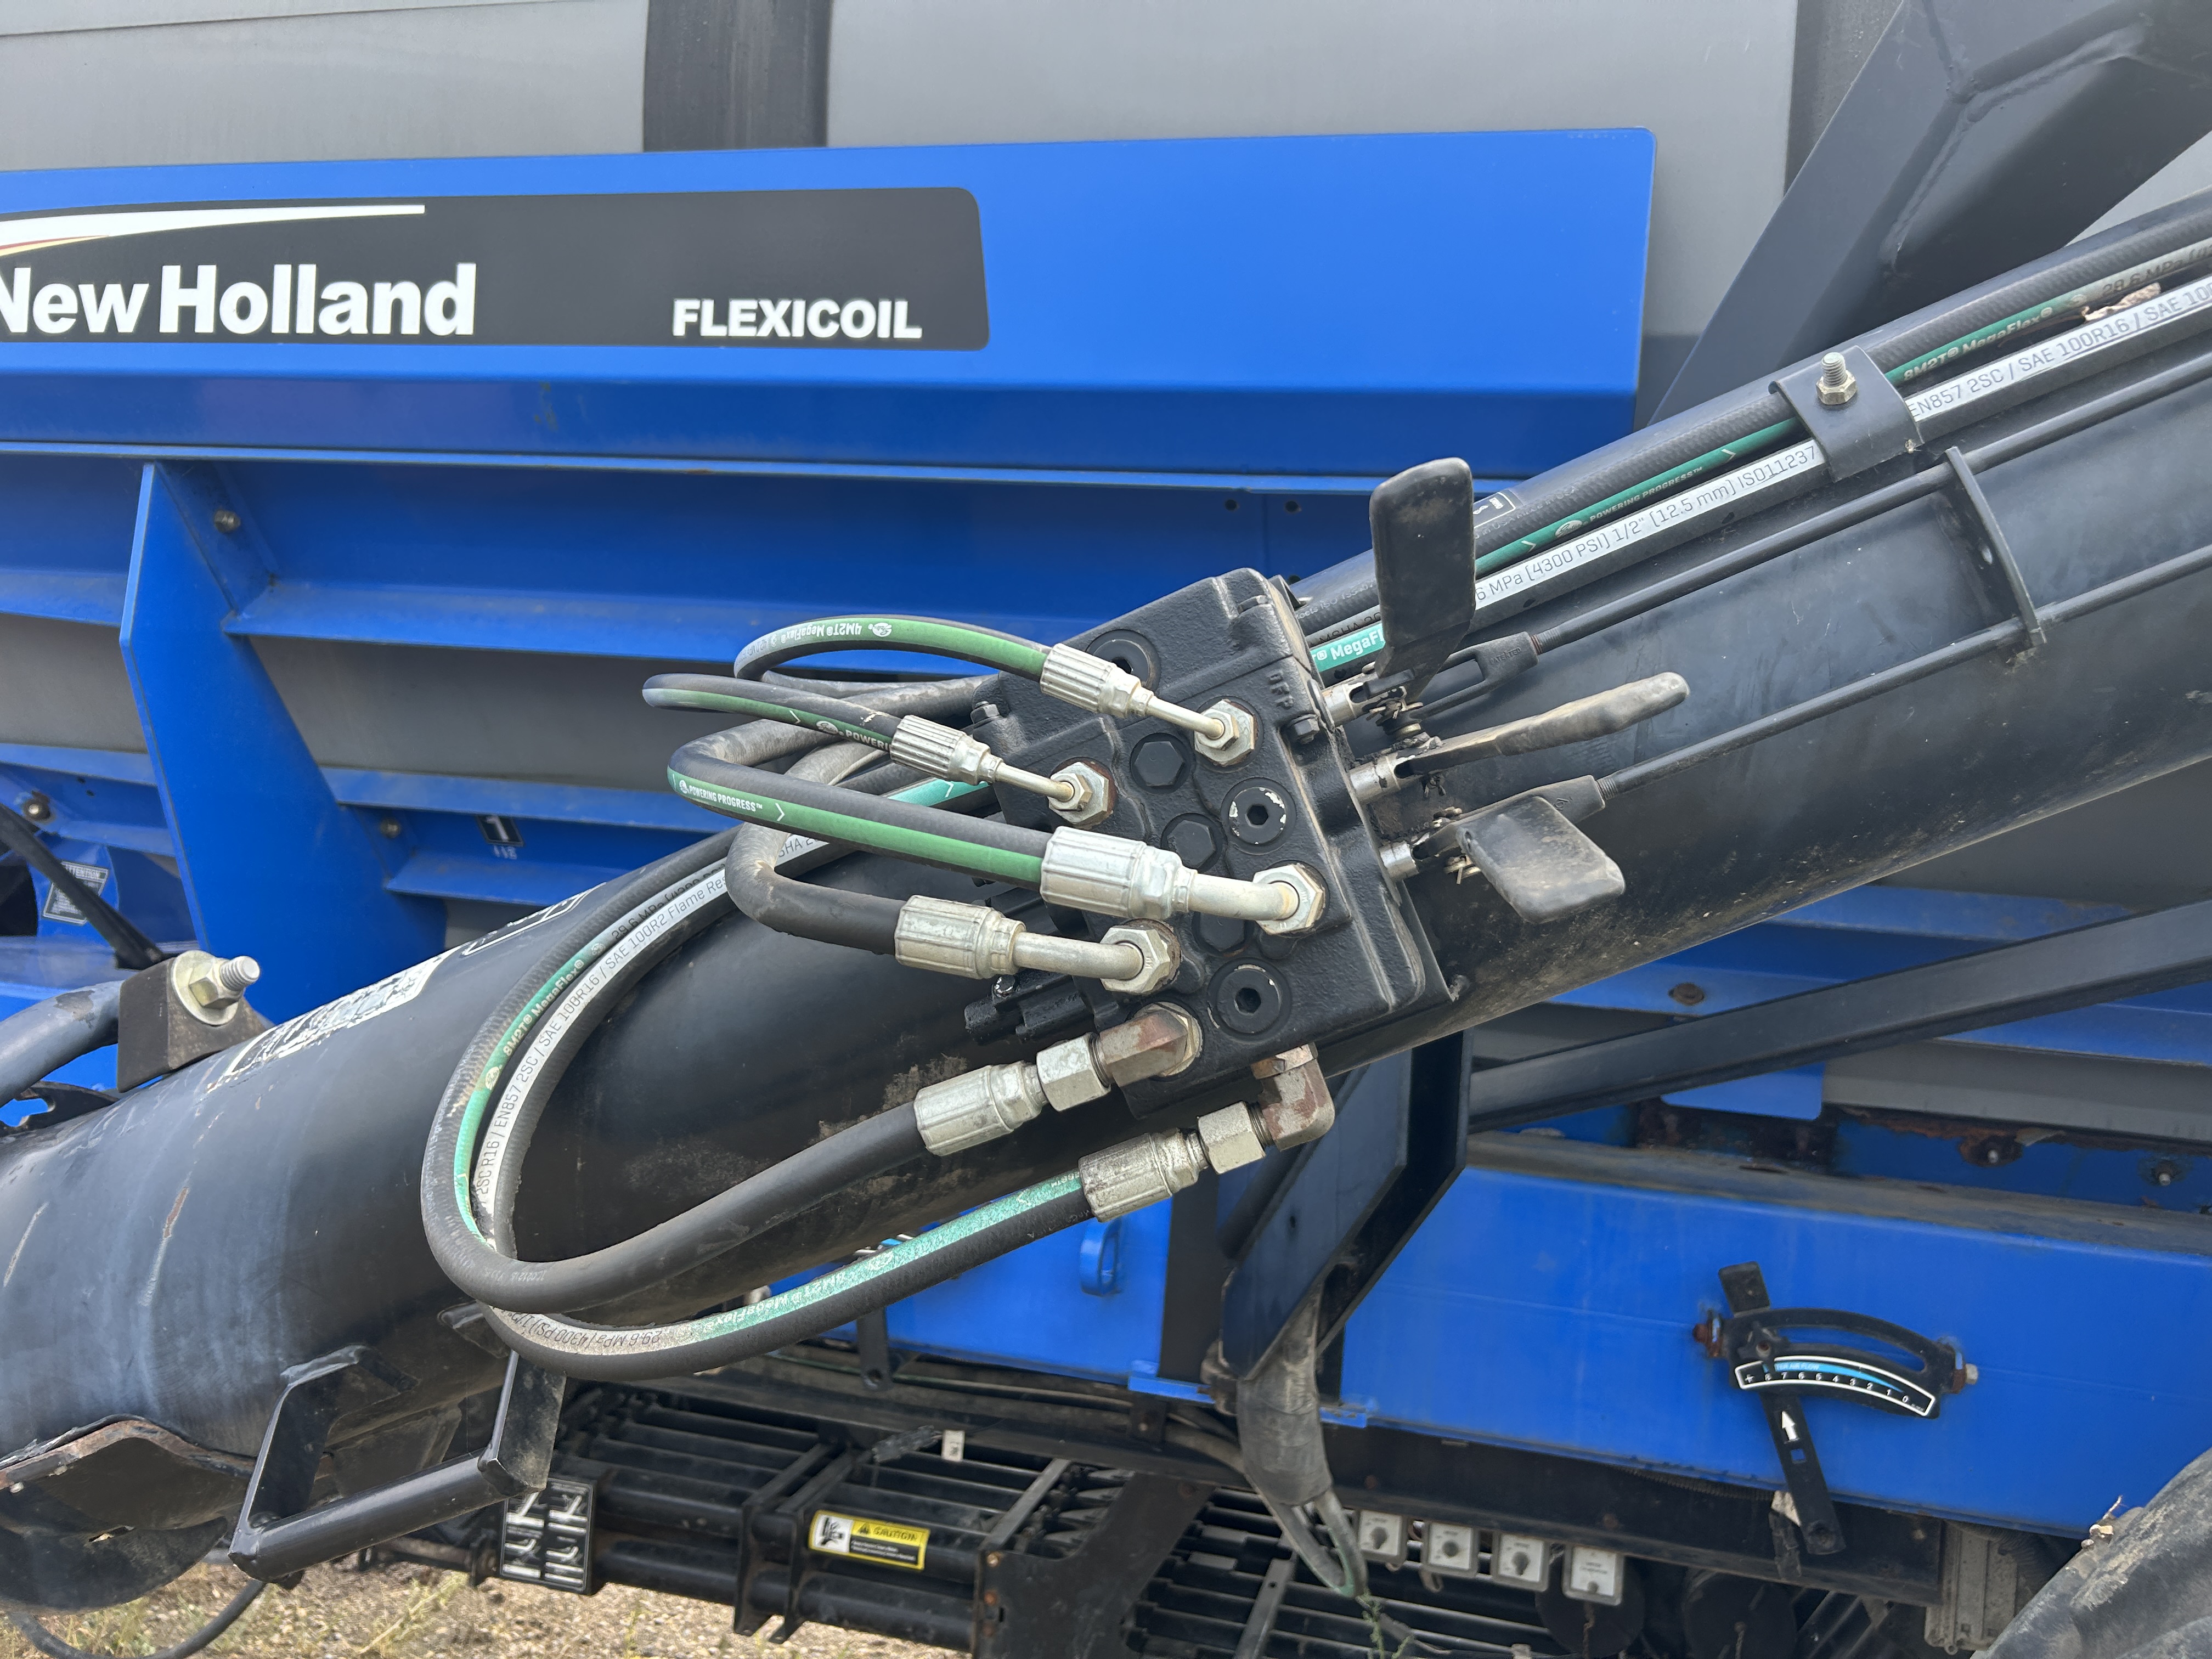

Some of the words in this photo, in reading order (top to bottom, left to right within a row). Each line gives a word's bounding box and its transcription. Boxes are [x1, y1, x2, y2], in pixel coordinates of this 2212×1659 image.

[159, 263, 477, 336] Holland
[673, 298, 923, 339] FLEXICOIL
[1967, 369, 2004, 393] 2SC
[2018, 348, 2056, 372] SAE
[2057, 318, 2130, 356] 100R16
[2144, 297, 2183, 321] SAE
[1489, 574, 1523, 595] MPa
[1739, 445, 1816, 489] ISO11237
[1589, 495, 1640, 522] POWERING
[689, 785, 718, 802] POWERING
[481, 1140, 500, 1167] R16
[494, 1084, 522, 1128] EN857
[516, 1056, 539, 1083] 2SC
[539, 1019, 562, 1047] SAE
[560, 973, 601, 1021] 100R16
[605, 948, 630, 969] SAE
[629, 914, 668, 950] 100R2
[668, 889, 706, 920] Flame
[596, 1333, 628, 1347] MPa
